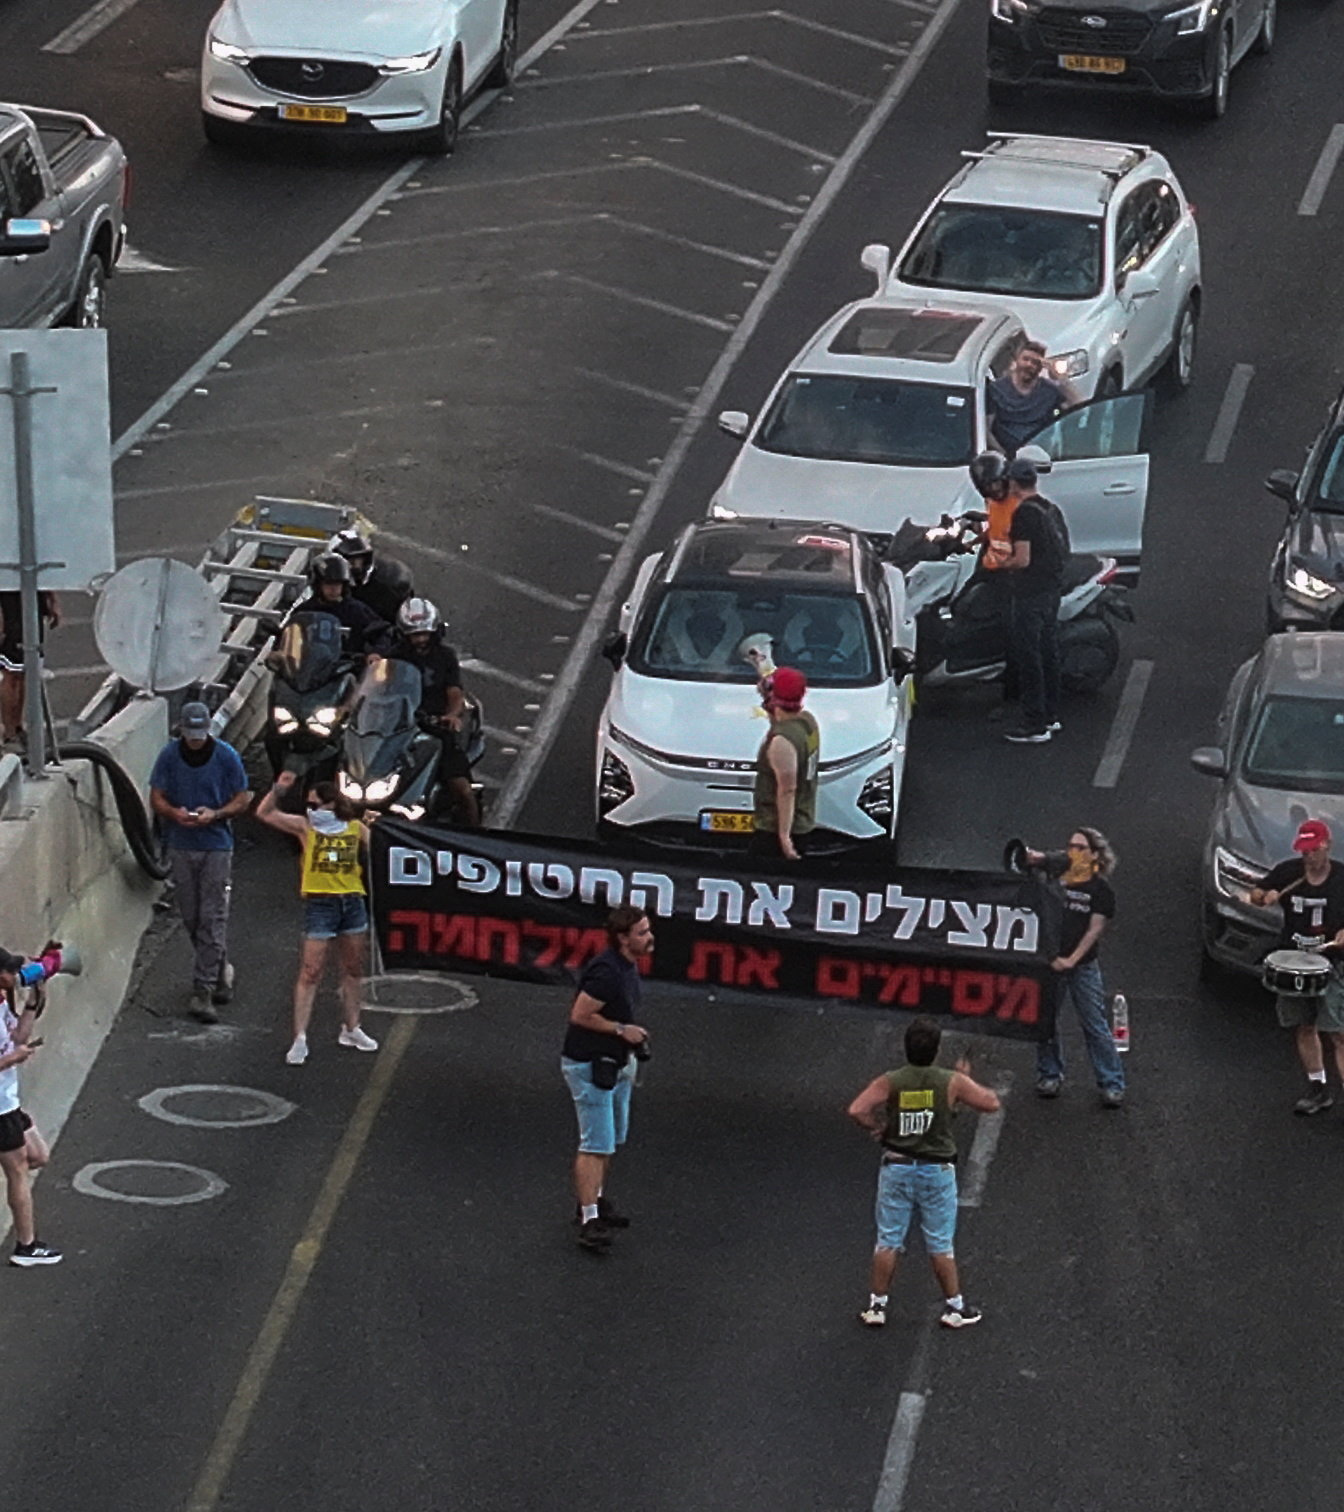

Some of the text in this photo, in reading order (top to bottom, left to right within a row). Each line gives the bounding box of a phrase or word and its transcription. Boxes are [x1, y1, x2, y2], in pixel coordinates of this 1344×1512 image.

[388, 845, 675, 918] החטופים
[694, 876, 794, 929] את
[815, 883, 1040, 953] מצילים
[387, 908, 1041, 1025] מסיימים את מלחמה
